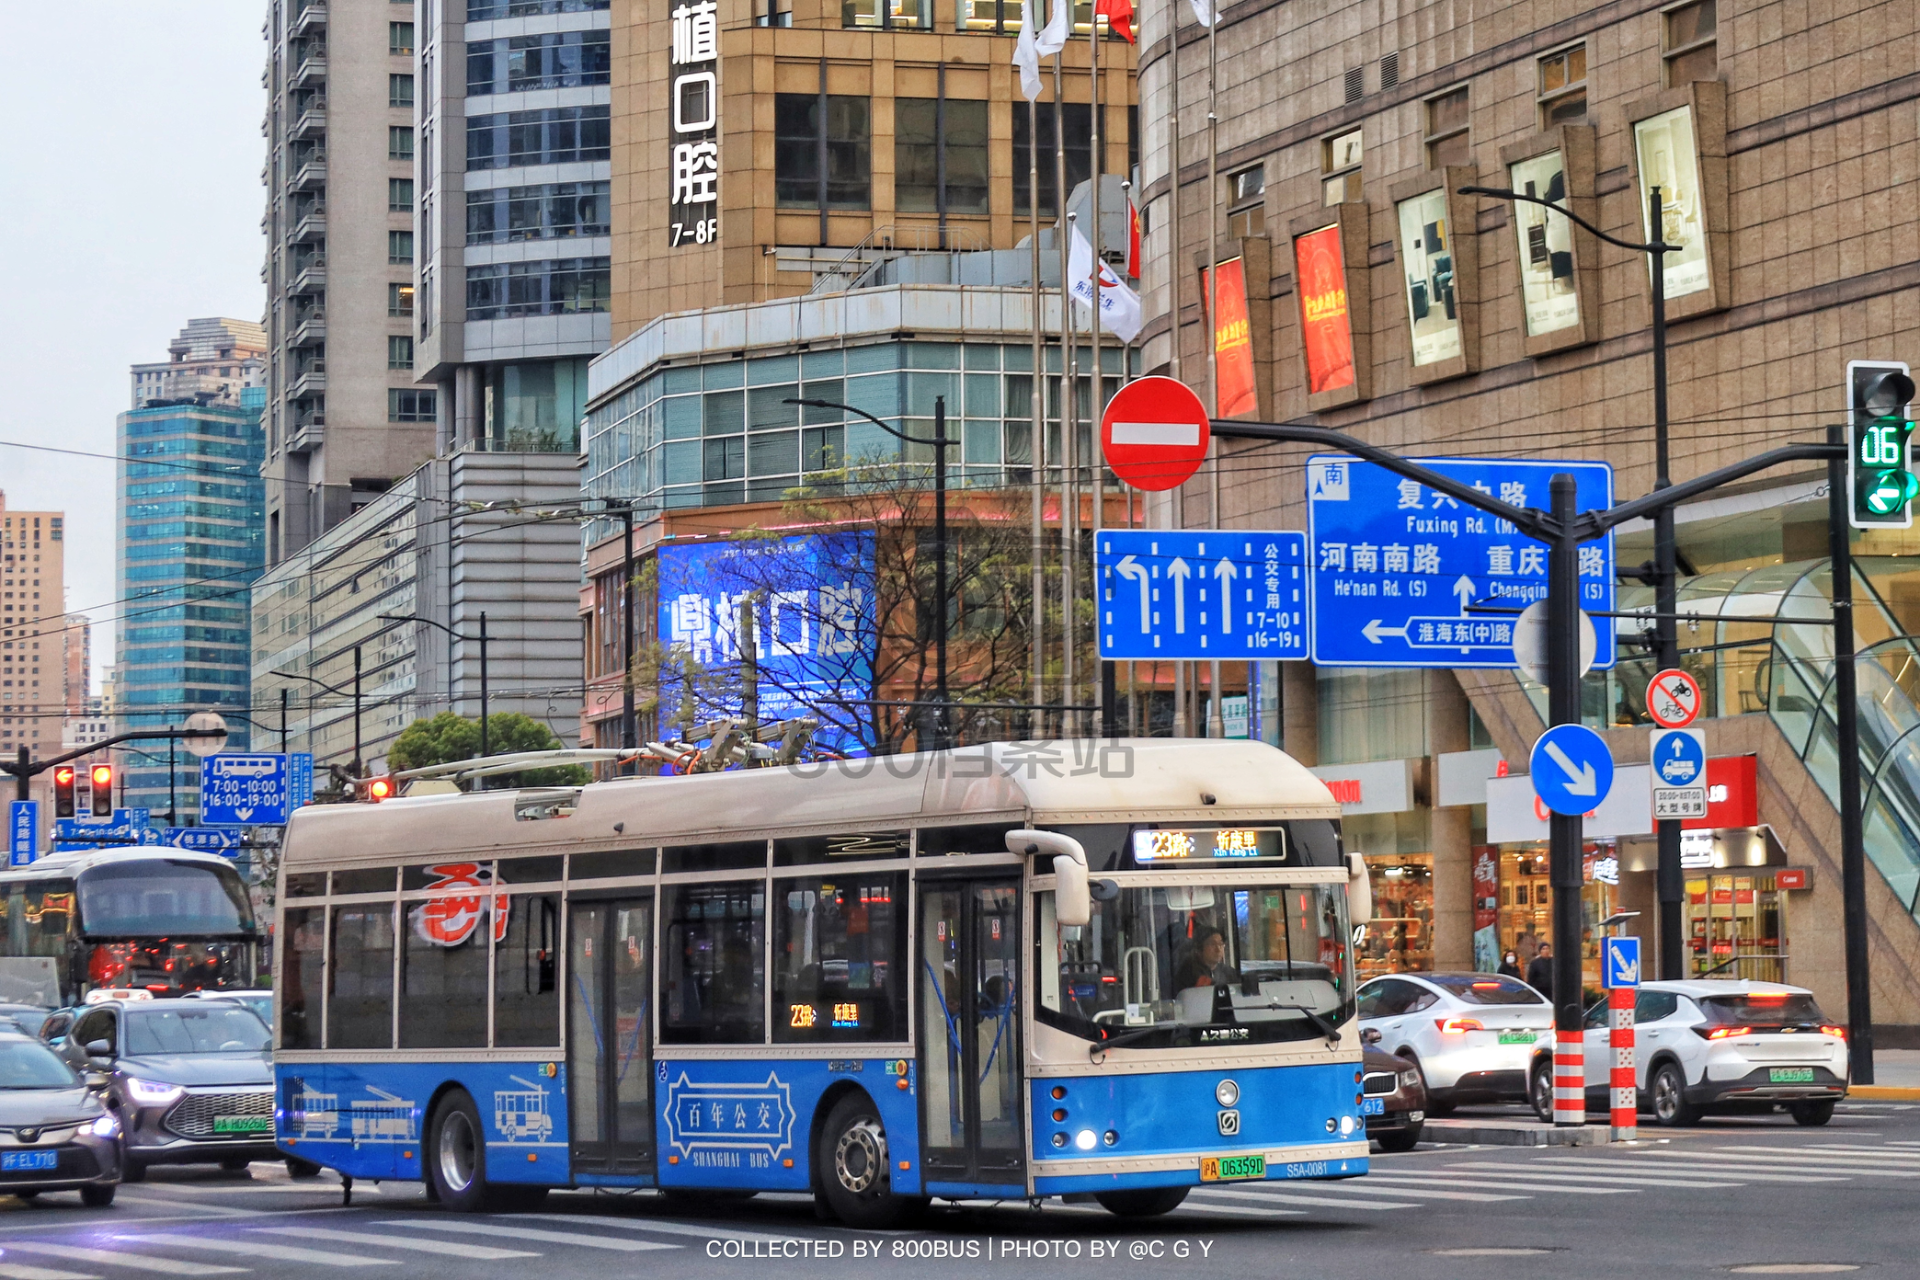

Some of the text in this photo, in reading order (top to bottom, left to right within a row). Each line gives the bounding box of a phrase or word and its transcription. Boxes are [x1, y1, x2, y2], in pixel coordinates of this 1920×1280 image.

[672, 1, 718, 205] 植口腔
[671, 217, 717, 248] 7-8F
[1861, 426, 1899, 464] 06
[1324, 463, 1343, 486] 南
[1406, 515, 1458, 538] Fuxing
[1465, 517, 1488, 534] Rd.
[1320, 541, 1606, 578] 河南南路 重庆路
[1264, 543, 1280, 610] 公交专用
[1334, 579, 1377, 596] He'nan
[1383, 580, 1402, 596] Rd.
[1408, 580, 1428, 597] (S)
[1584, 583, 1603, 600] (S)
[1256, 612, 1290, 629] 7-10
[1255, 631, 1293, 648] 16-19
[1418, 622, 1512, 644] 淮海东(中)路
[212, 779, 277, 794] 7:00-10:00
[208, 793, 280, 807] 16:00-19:00
[1657, 802, 1702, 813] 大型号牌
[688, 1102, 771, 1130] 百年公交
[692, 1151, 770, 1168] SHANGHAI BUS
[1286, 1161, 1328, 1178] S5A-0081
